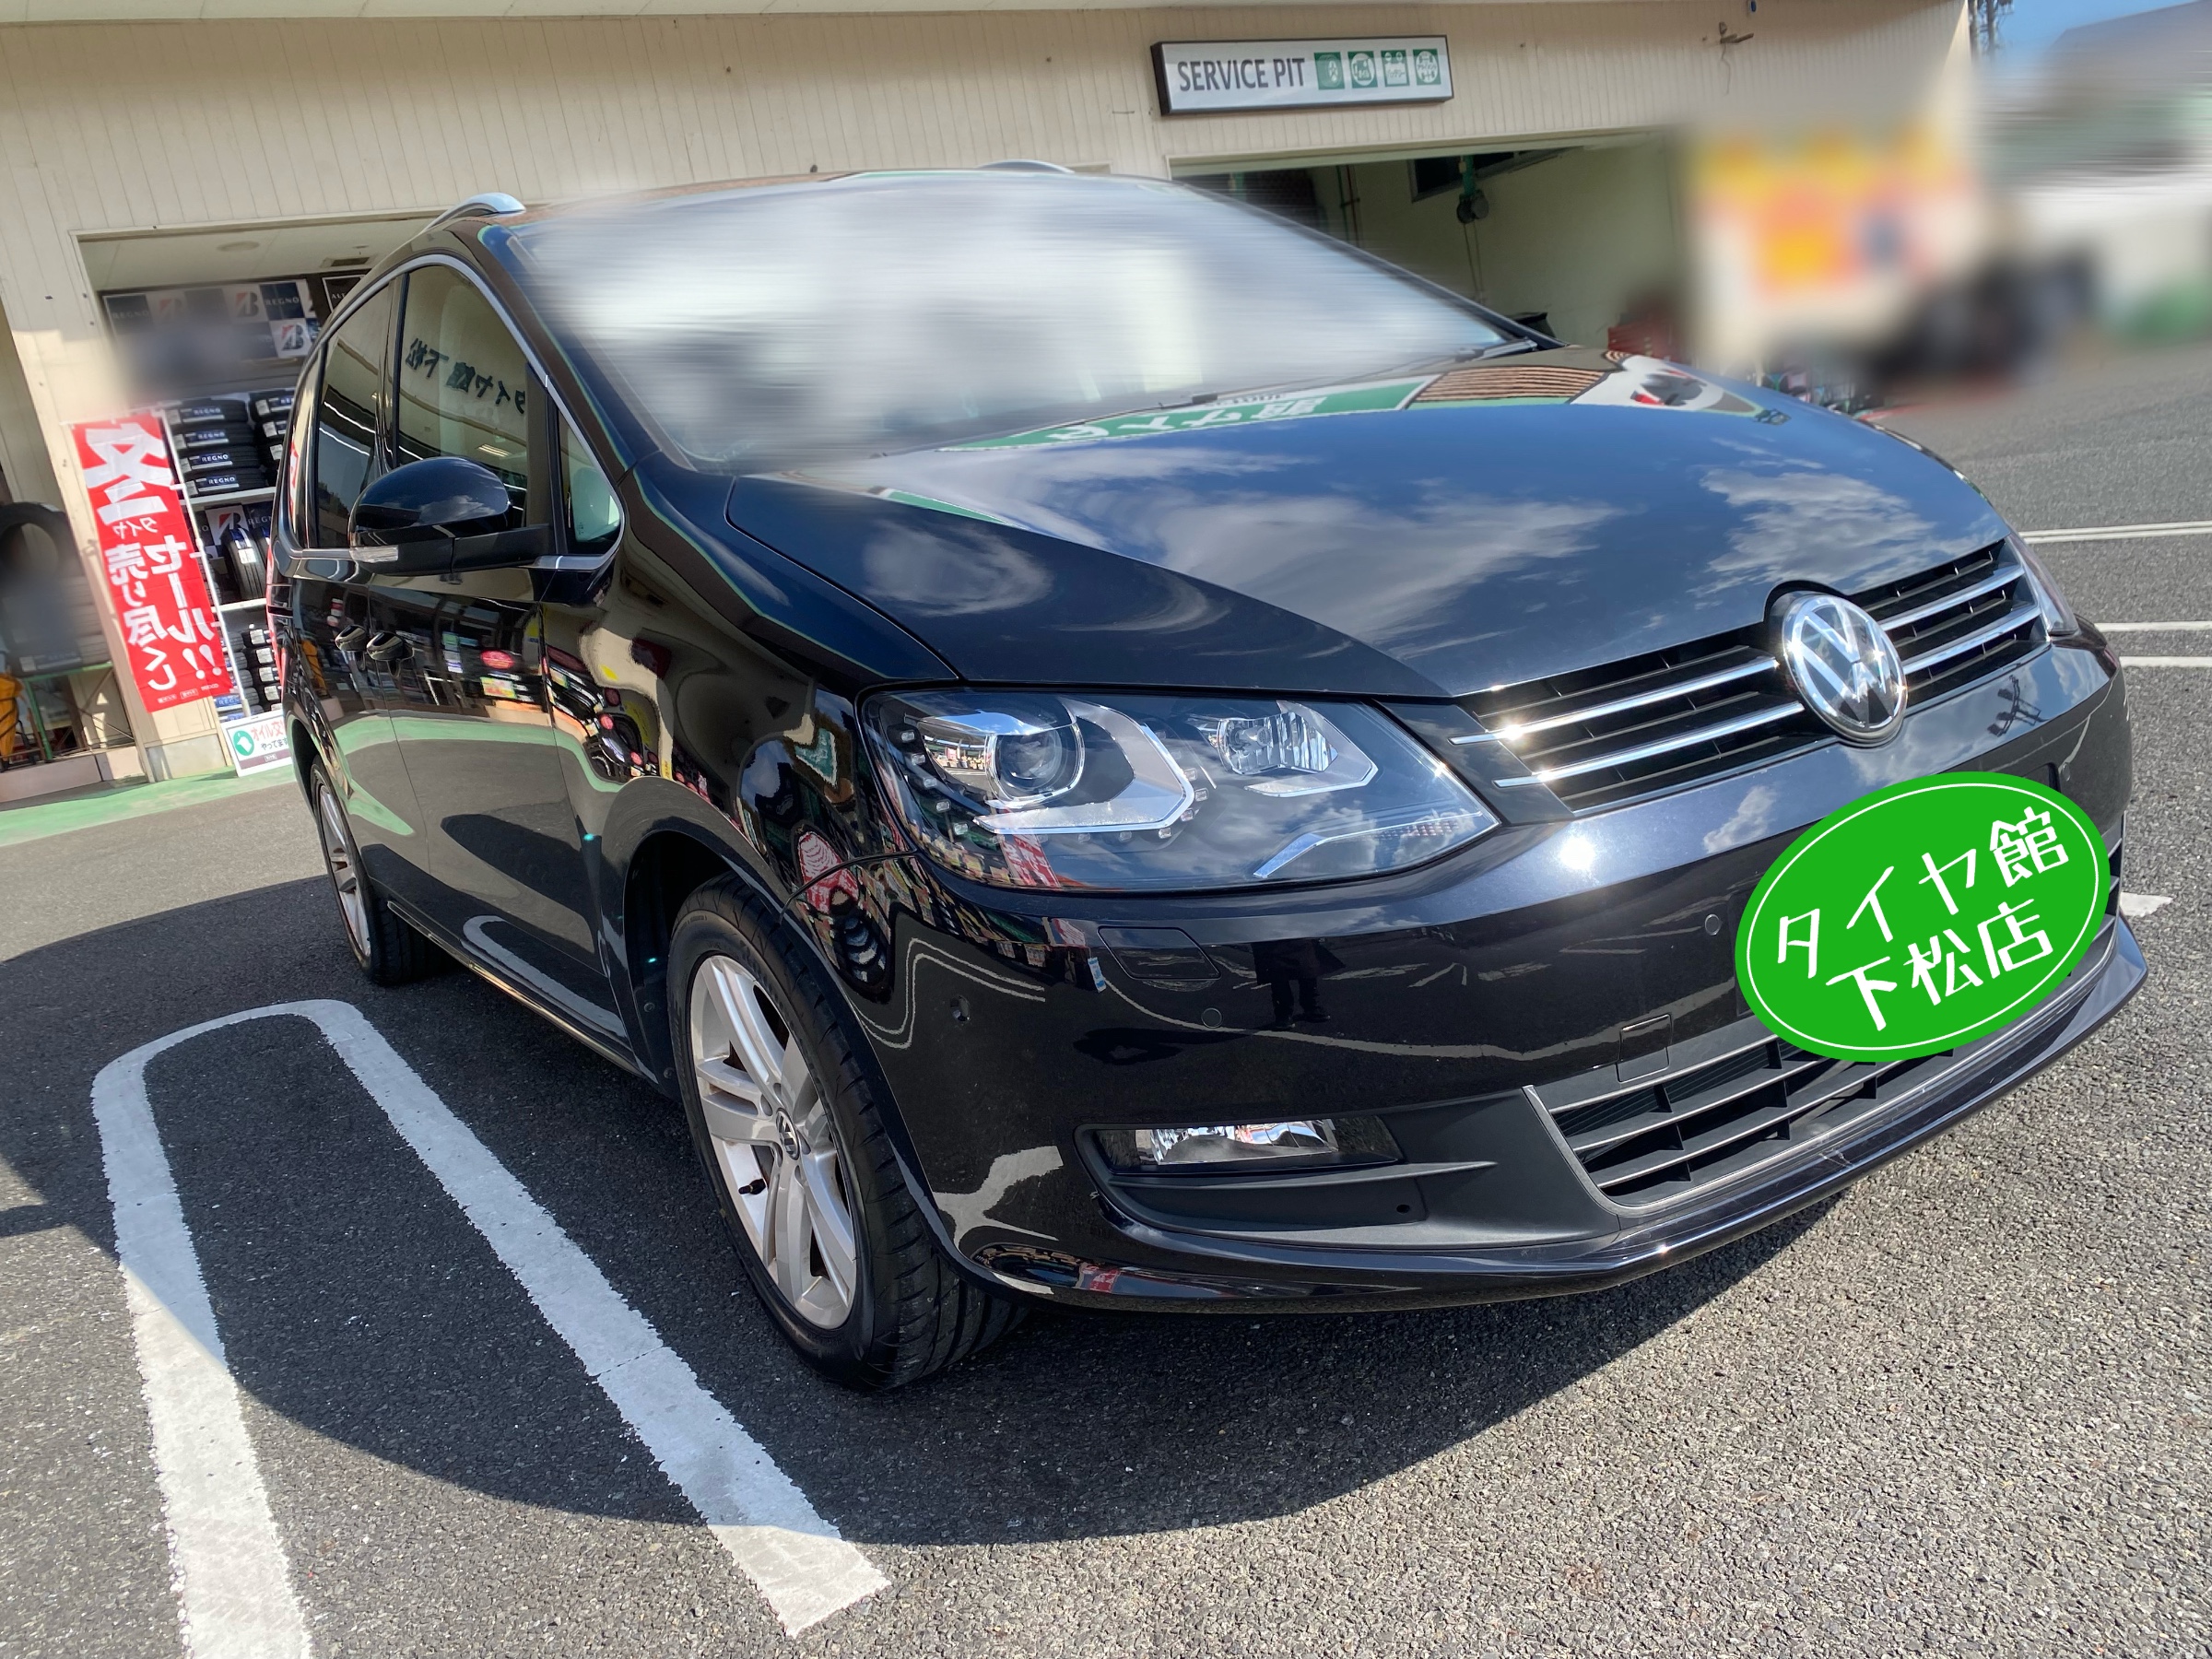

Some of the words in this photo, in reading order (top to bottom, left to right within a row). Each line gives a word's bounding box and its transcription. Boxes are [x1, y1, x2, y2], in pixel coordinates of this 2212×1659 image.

[1177, 58, 1268, 91] SERVICE
[1273, 57, 1305, 88] PIT
[265, 297, 300, 306] REGNO
[202, 453, 229, 462] REGNO
[208, 477, 236, 485] REGNO
[251, 720, 284, 741] オイル交
